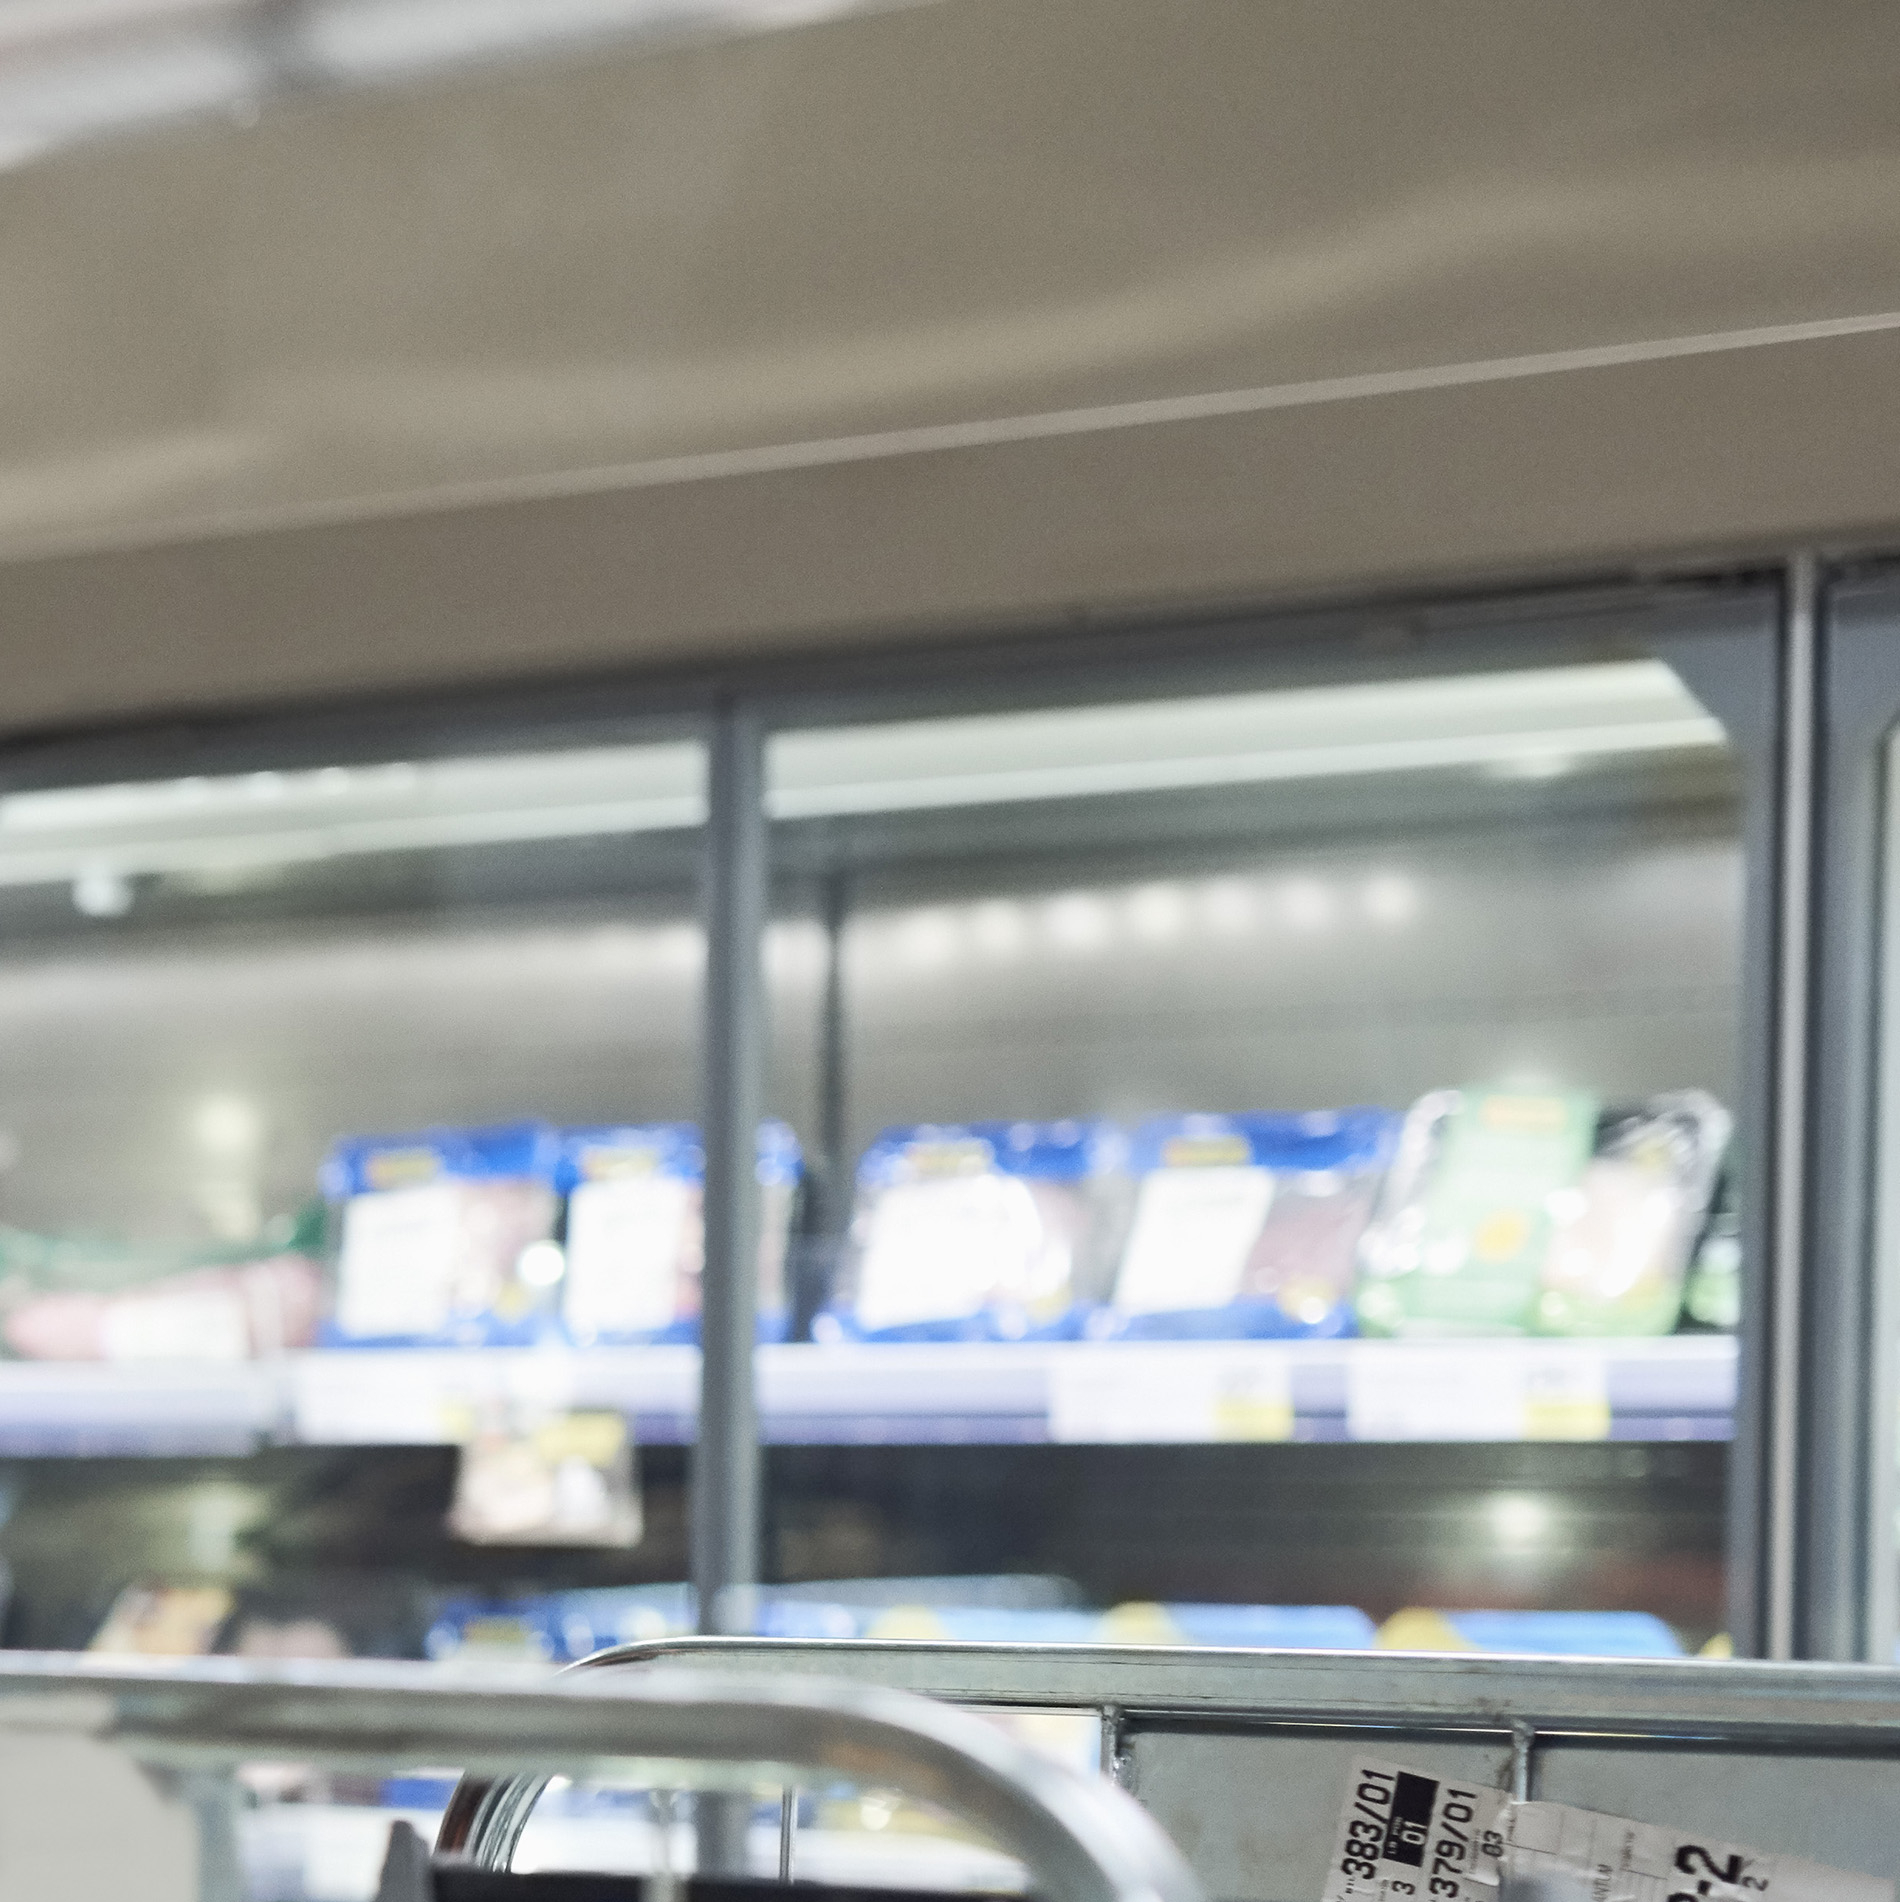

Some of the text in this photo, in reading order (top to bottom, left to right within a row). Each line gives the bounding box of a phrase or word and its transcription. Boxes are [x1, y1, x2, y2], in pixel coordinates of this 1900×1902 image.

[1340, 1768, 1396, 1880] 383/01
[1399, 1821, 1429, 1846] 01
[1428, 1788, 1478, 1899] 379/01
[1480, 1830, 1505, 1858] 03
[1390, 1880, 1416, 1895] 3
